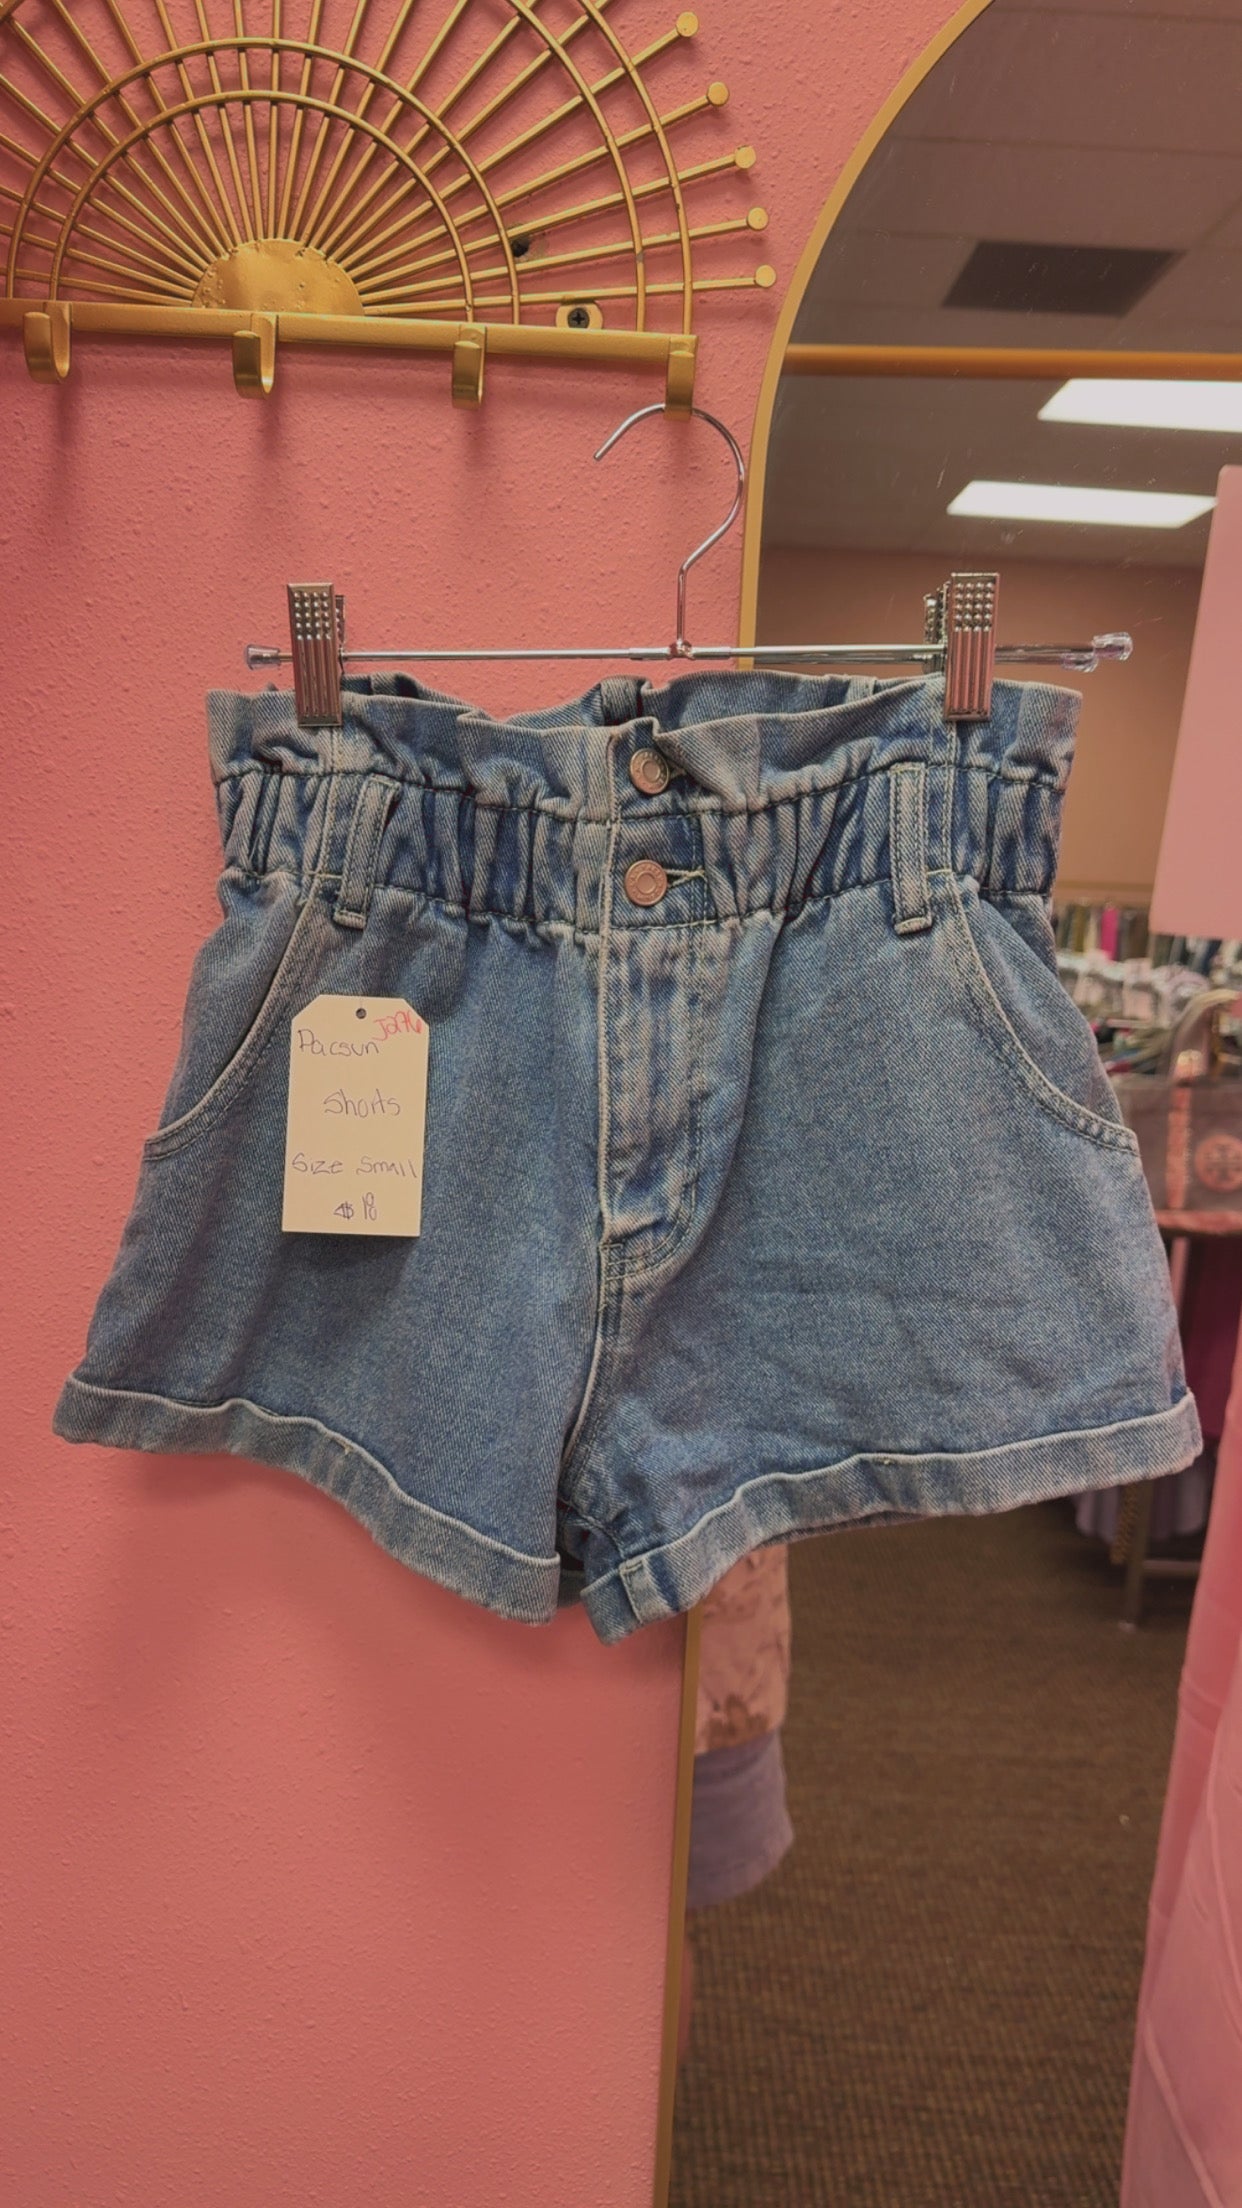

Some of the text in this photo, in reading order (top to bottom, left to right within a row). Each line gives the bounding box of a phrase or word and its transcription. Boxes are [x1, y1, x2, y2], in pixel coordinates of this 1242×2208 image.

[298, 1028, 379, 1056] Pacsun
[323, 1088, 401, 1118] Shorts
[292, 1152, 417, 1178] Size Small
